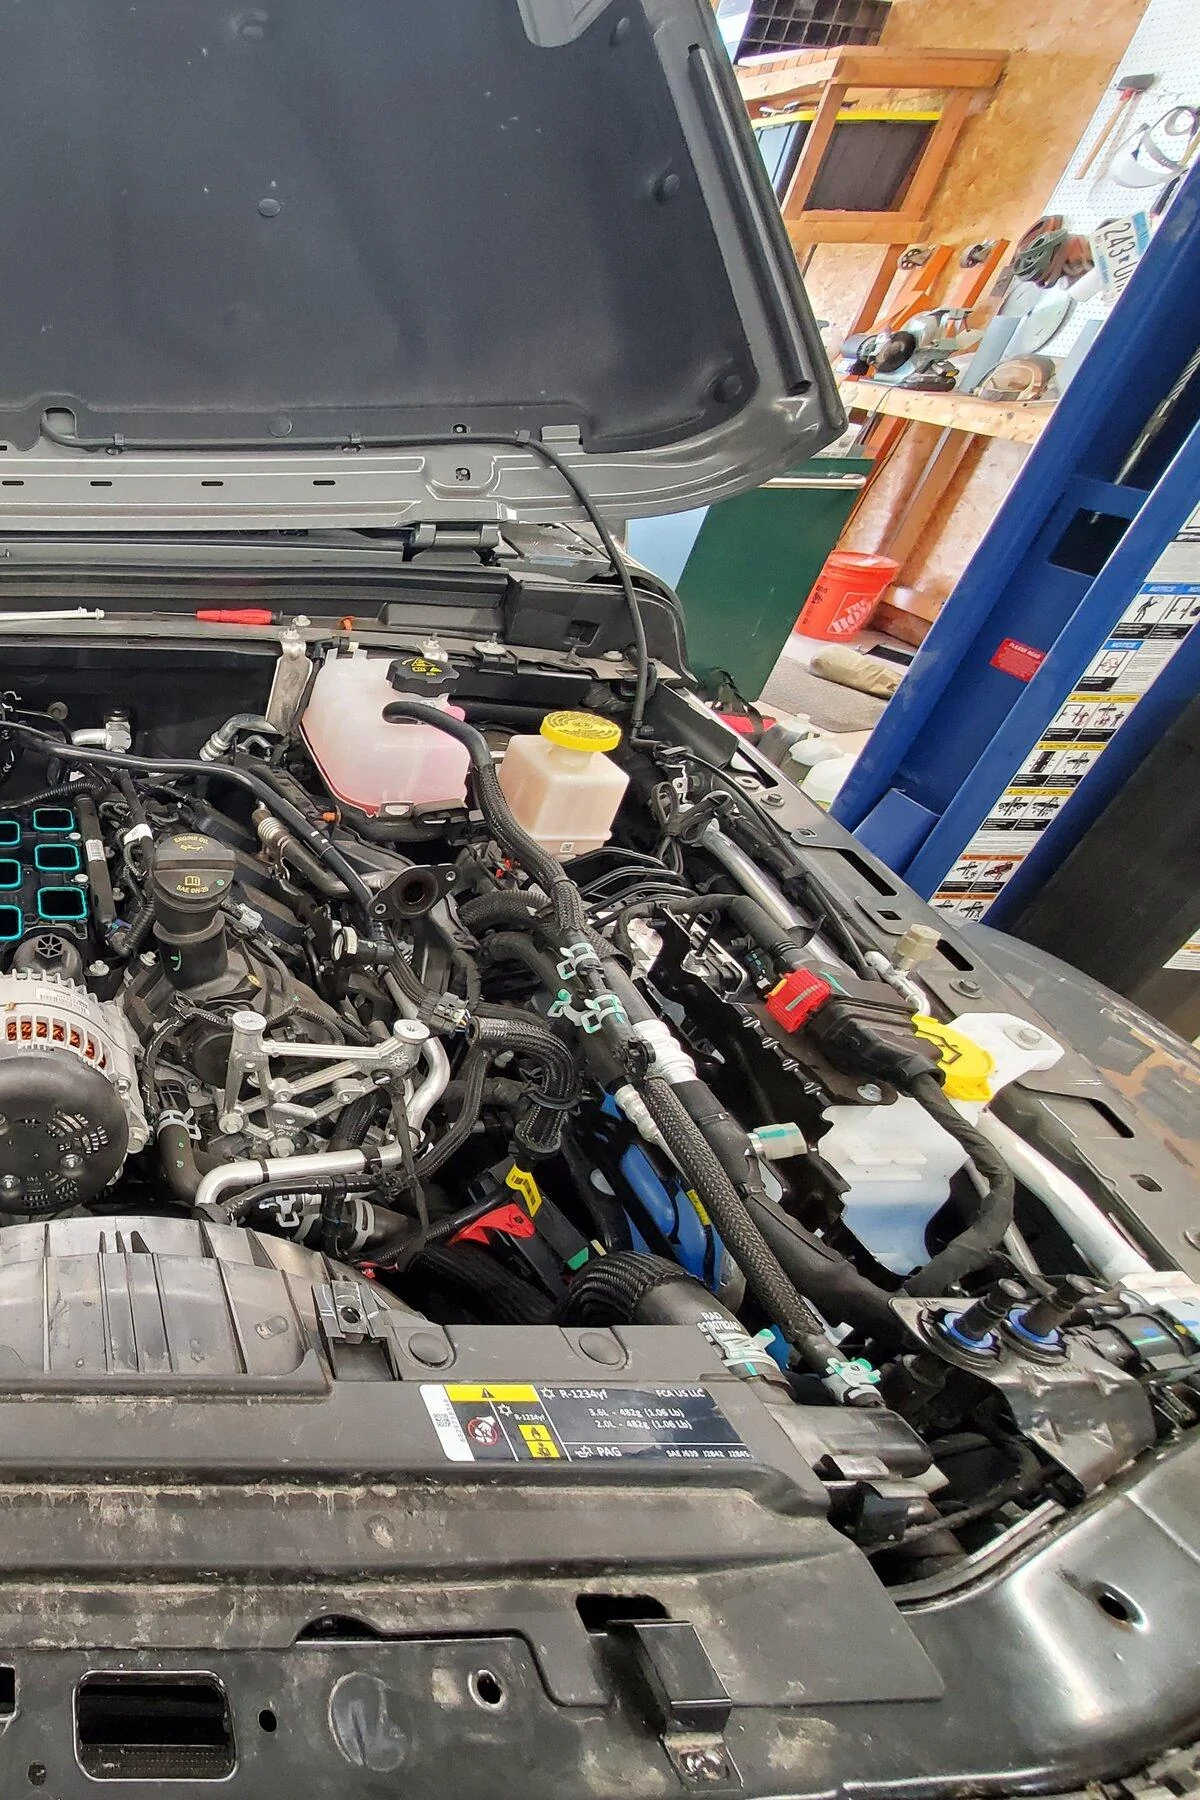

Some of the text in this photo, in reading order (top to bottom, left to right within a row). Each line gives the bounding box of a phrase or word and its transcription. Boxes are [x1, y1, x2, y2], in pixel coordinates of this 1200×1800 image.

[1110, 641, 1136, 649] NOTICE
[198, 837, 209, 845] OIL
[176, 884, 189, 893] SAE
[700, 1311, 723, 1320] RAD
[559, 1388, 608, 1400] R-1234yf
[655, 1388, 706, 1398] FCA US LLC
[587, 1408, 609, 1417] 3.6L
[619, 1408, 643, 1418] 482g
[643, 1407, 667, 1418] (1.06
[667, 1407, 685, 1418] Lb)
[514, 1413, 546, 1422] R-1234yf
[594, 1420, 617, 1428] 2.0L
[626, 1420, 650, 1430] 482g
[651, 1419, 675, 1430] (1.06
[675, 1420, 693, 1430] Lb)
[596, 1446, 623, 1457] PAG
[665, 1450, 682, 1458] SAE
